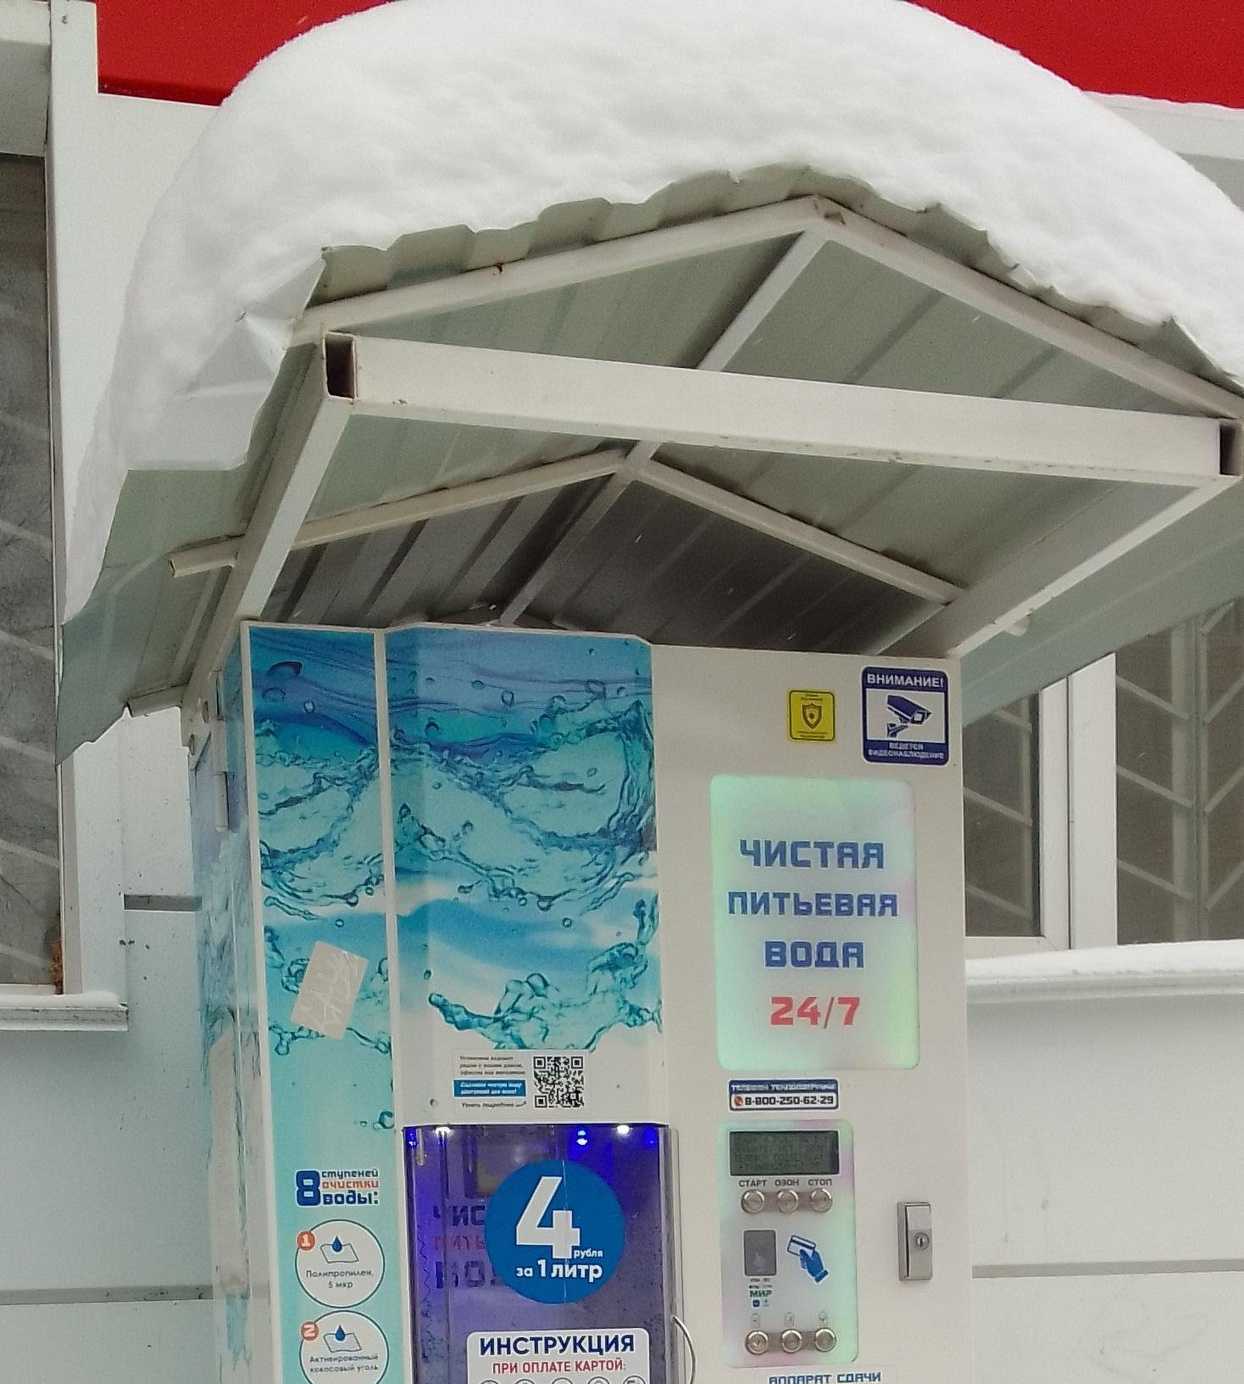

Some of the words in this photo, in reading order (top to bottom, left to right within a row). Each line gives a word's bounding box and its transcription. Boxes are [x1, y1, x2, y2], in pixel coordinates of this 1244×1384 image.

[867, 673, 944, 688] ВНИМАНИЕ!
[740, 839, 885, 869] ЧИСТАЯ
[728, 892, 898, 917] ПИТЬЕВАЯ
[765, 940, 865, 969] ВОДА
[770, 996, 861, 1029] 24/7
[745, 1096, 834, 1106] 8-800-250-62-29
[321, 1168, 379, 1179] ступеней
[296, 1170, 321, 1206] 8
[322, 1179, 379, 1190] очистки
[738, 1179, 767, 1187] СТАРТ
[774, 1179, 800, 1187] ОЗОН
[807, 1178, 832, 1187] СТОП
[322, 1191, 379, 1205] воды:
[516, 1175, 581, 1259] 4
[302, 1235, 311, 1247] 1
[573, 1248, 603, 1258] рубля
[516, 1267, 533, 1278] за
[537, 1259, 546, 1278] 1
[551, 1262, 603, 1282] литр
[336, 1281, 354, 1290] мкр
[304, 1325, 317, 1337] 2
[479, 1334, 635, 1356] ИНСТРУКЦИЯ
[492, 1362, 518, 1375] ПРИ
[522, 1360, 571, 1374] ОПЛАТЕ
[575, 1358, 626, 1372] КАРТОЙ:
[837, 1372, 881, 1384] СДАЧИ
